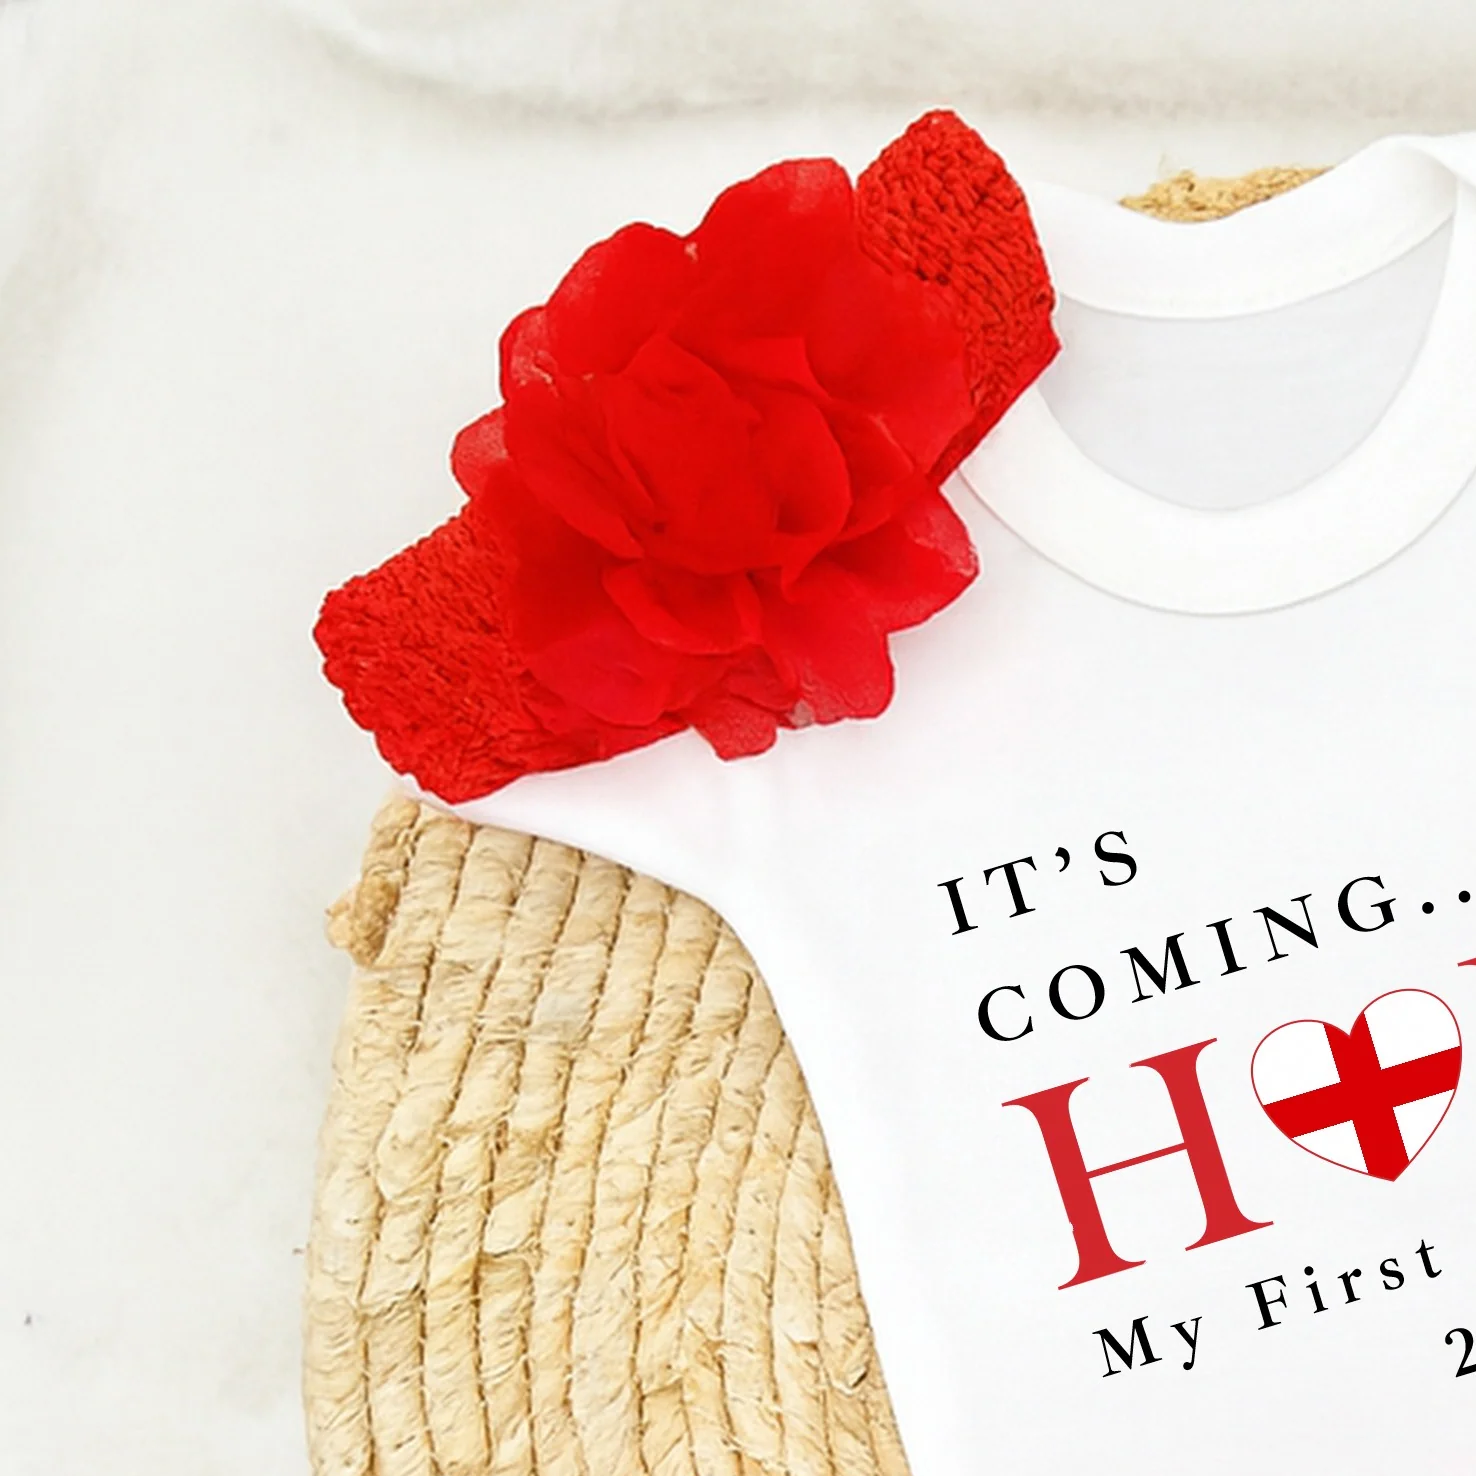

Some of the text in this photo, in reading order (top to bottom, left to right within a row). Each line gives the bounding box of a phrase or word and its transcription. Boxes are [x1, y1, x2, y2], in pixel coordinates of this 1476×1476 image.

[936, 830, 1138, 936] IT’S
[1091, 1315, 1203, 1378] My
[1244, 1239, 1443, 1331] First
